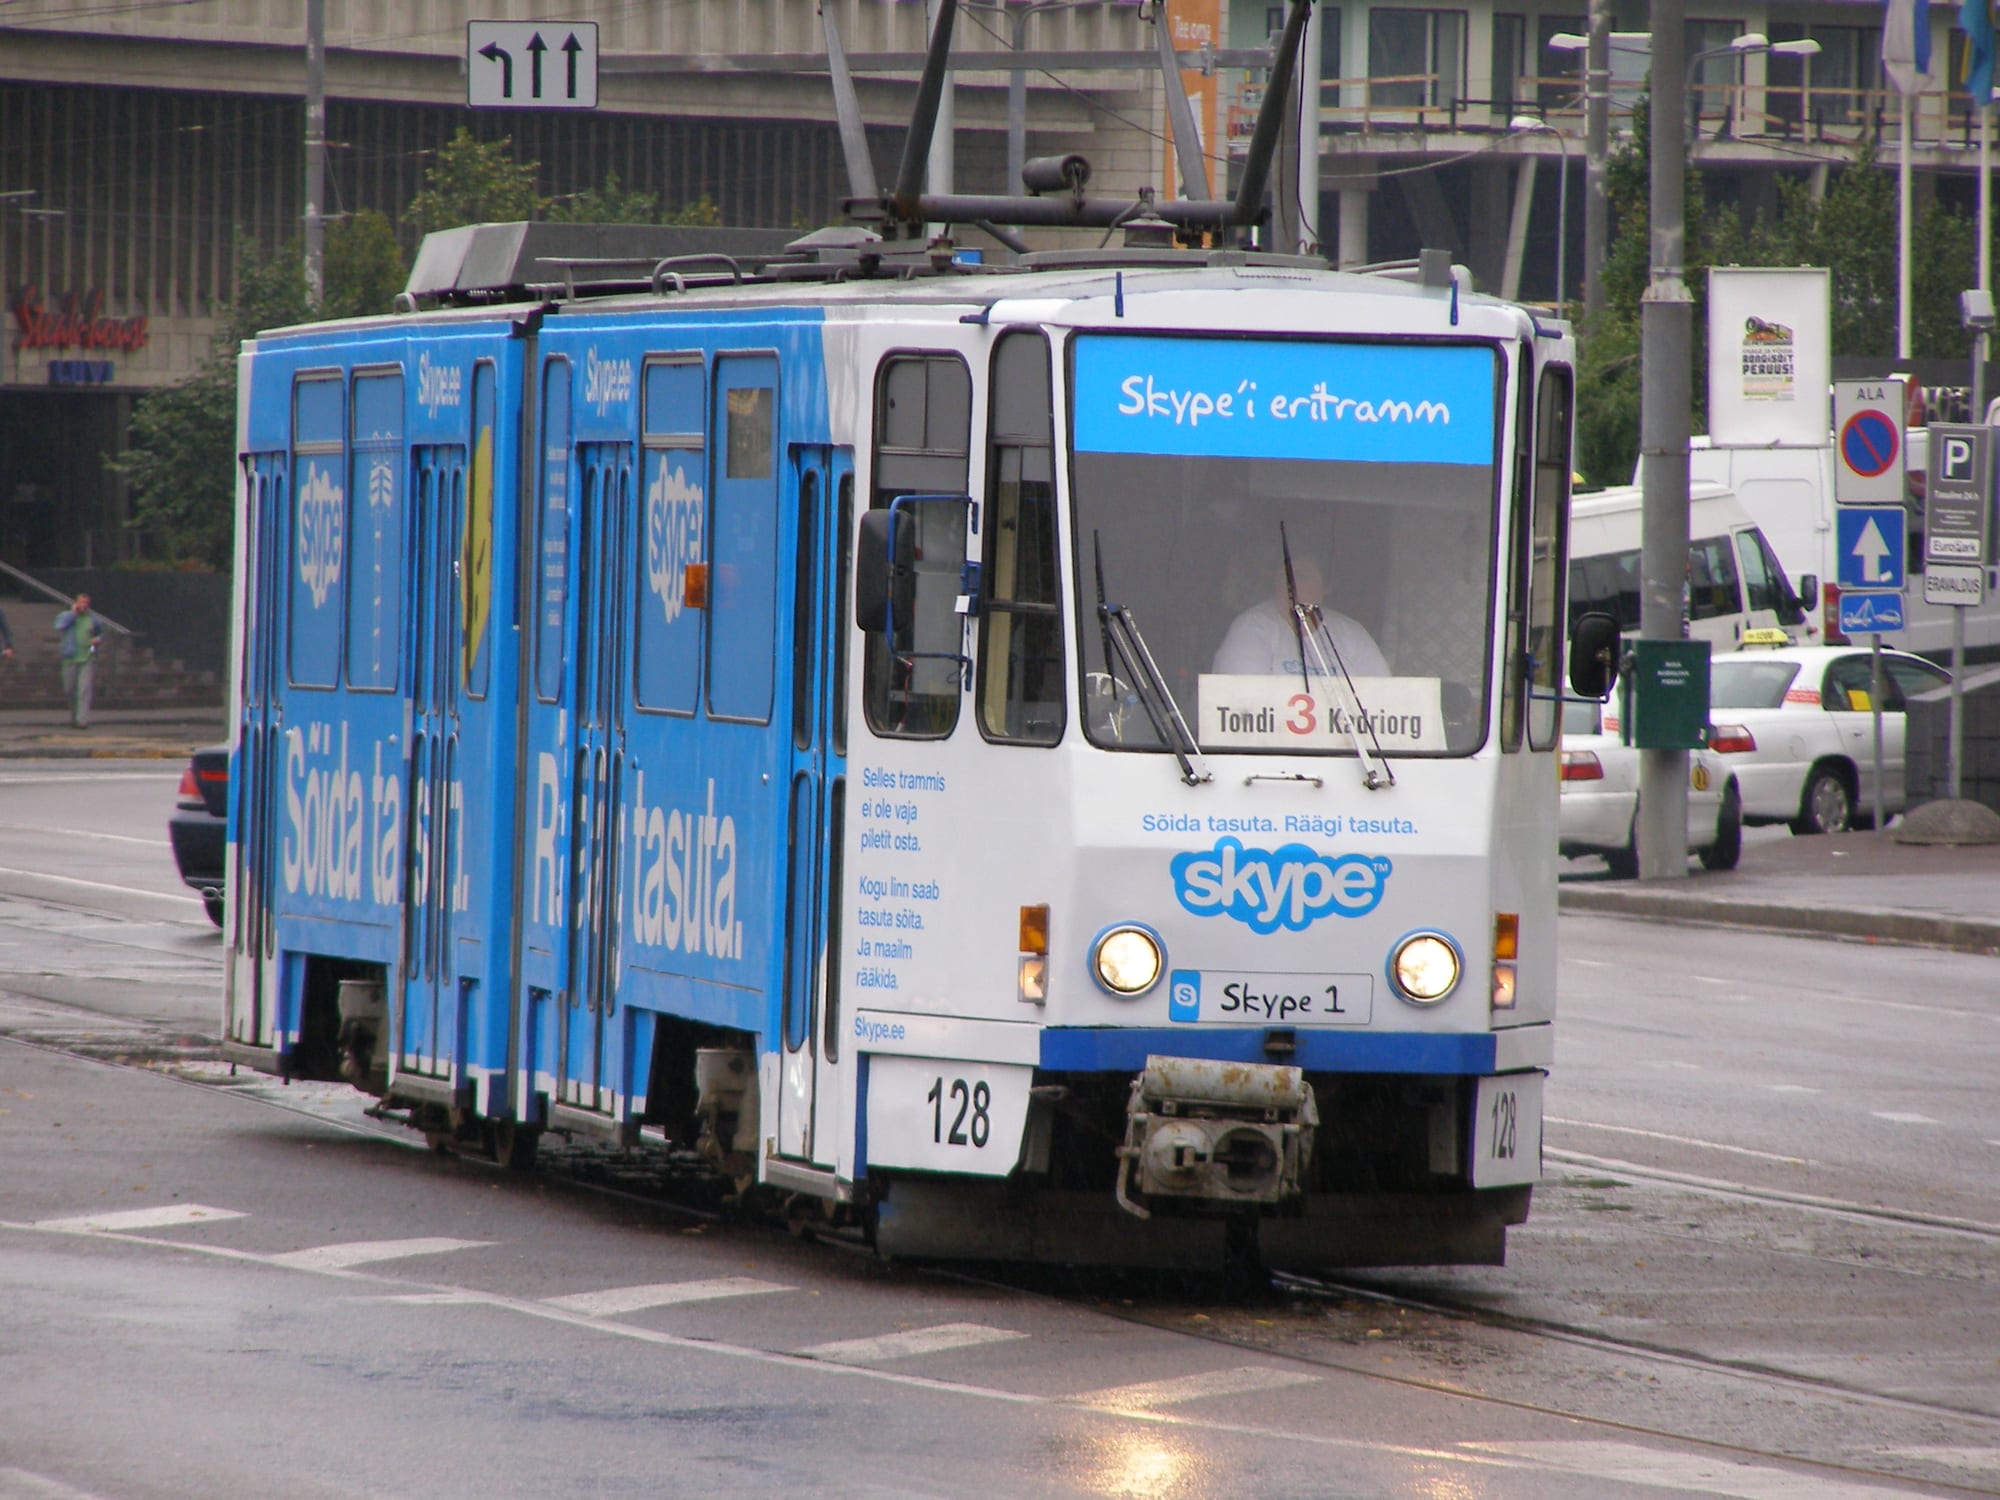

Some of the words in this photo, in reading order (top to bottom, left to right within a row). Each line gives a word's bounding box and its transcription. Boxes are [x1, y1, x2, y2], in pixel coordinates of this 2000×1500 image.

[587, 345, 630, 416] Skype.ee
[1118, 374, 1257, 427] Skype'i
[1271, 381, 1450, 425] eritramm
[1856, 387, 1885, 400] ALA
[1945, 439, 1970, 477] P
[1927, 575, 1980, 593] ERAVALDUS
[1216, 706, 1275, 733] Tondi
[1286, 693, 1316, 735] 3
[863, 767, 896, 789] Selles
[900, 770, 945, 792] trammis
[283, 719, 363, 902] Sõida
[862, 799, 871, 817] ei
[875, 800, 892, 819] ole
[896, 803, 917, 824] vaja
[1142, 814, 1201, 832] Sõida
[1208, 816, 1278, 832] tasuta.
[1284, 815, 1342, 837] Räägi
[1350, 816, 1419, 834] tasuta.
[861, 828, 892, 851] piletit
[894, 833, 921, 851] osta.
[632, 769, 743, 961] tasuta.
[859, 876, 888, 901] Kogu
[890, 878, 910, 898] linn
[912, 880, 939, 900] saab
[1184, 845, 1376, 923] skype
[858, 907, 893, 927] tasuta
[896, 908, 924, 930] sõita.
[857, 937, 871, 956] Ja
[875, 938, 912, 960] maailm
[856, 968, 899, 989] rääkida.
[1221, 983, 1312, 1019] Skype
[1324, 985, 1345, 1013] 1
[855, 1017, 905, 1042] Skype.ee
[928, 1076, 991, 1148] 128
[1491, 1091, 1517, 1159] 128
